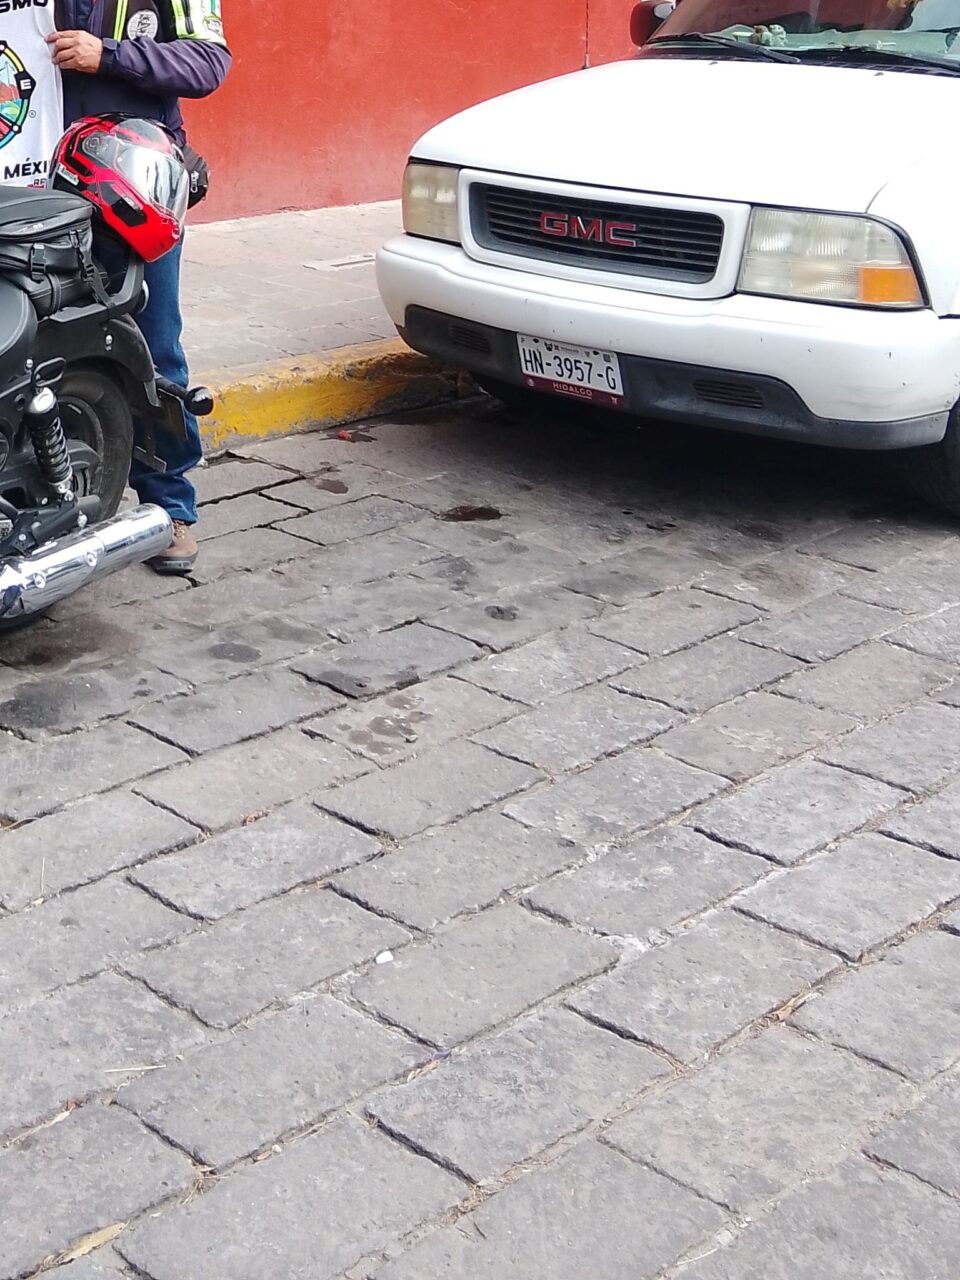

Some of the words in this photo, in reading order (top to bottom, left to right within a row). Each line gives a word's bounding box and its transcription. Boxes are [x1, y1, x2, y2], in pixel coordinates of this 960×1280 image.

[20, 79, 32, 90] E
[4, 157, 48, 180] MÉXI
[540, 212, 636, 247] GMC
[522, 348, 616, 390] HN-3957-G
[552, 381, 592, 396] HIDALGO
